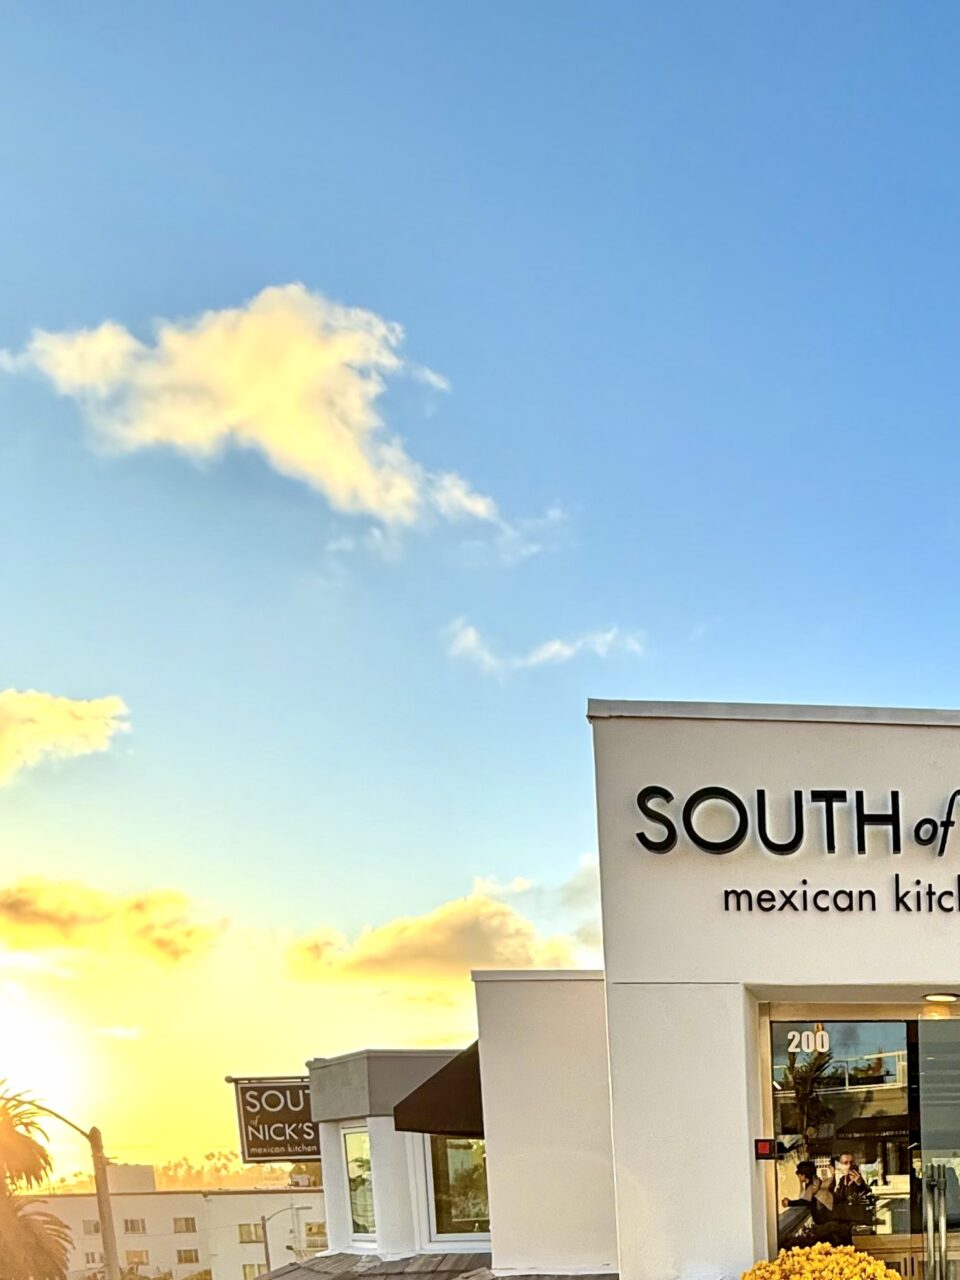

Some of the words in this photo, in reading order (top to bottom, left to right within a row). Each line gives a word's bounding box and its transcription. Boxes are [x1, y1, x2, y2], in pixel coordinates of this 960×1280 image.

[635, 785, 901, 856] SOUTH
[723, 878, 876, 913] mexican
[787, 1030, 830, 1053] 200
[245, 1089, 311, 1113] SOU
[247, 1122, 315, 1141] NICK'S
[250, 1145, 286, 1154] mexican
[287, 1143, 318, 1153] kitchen
